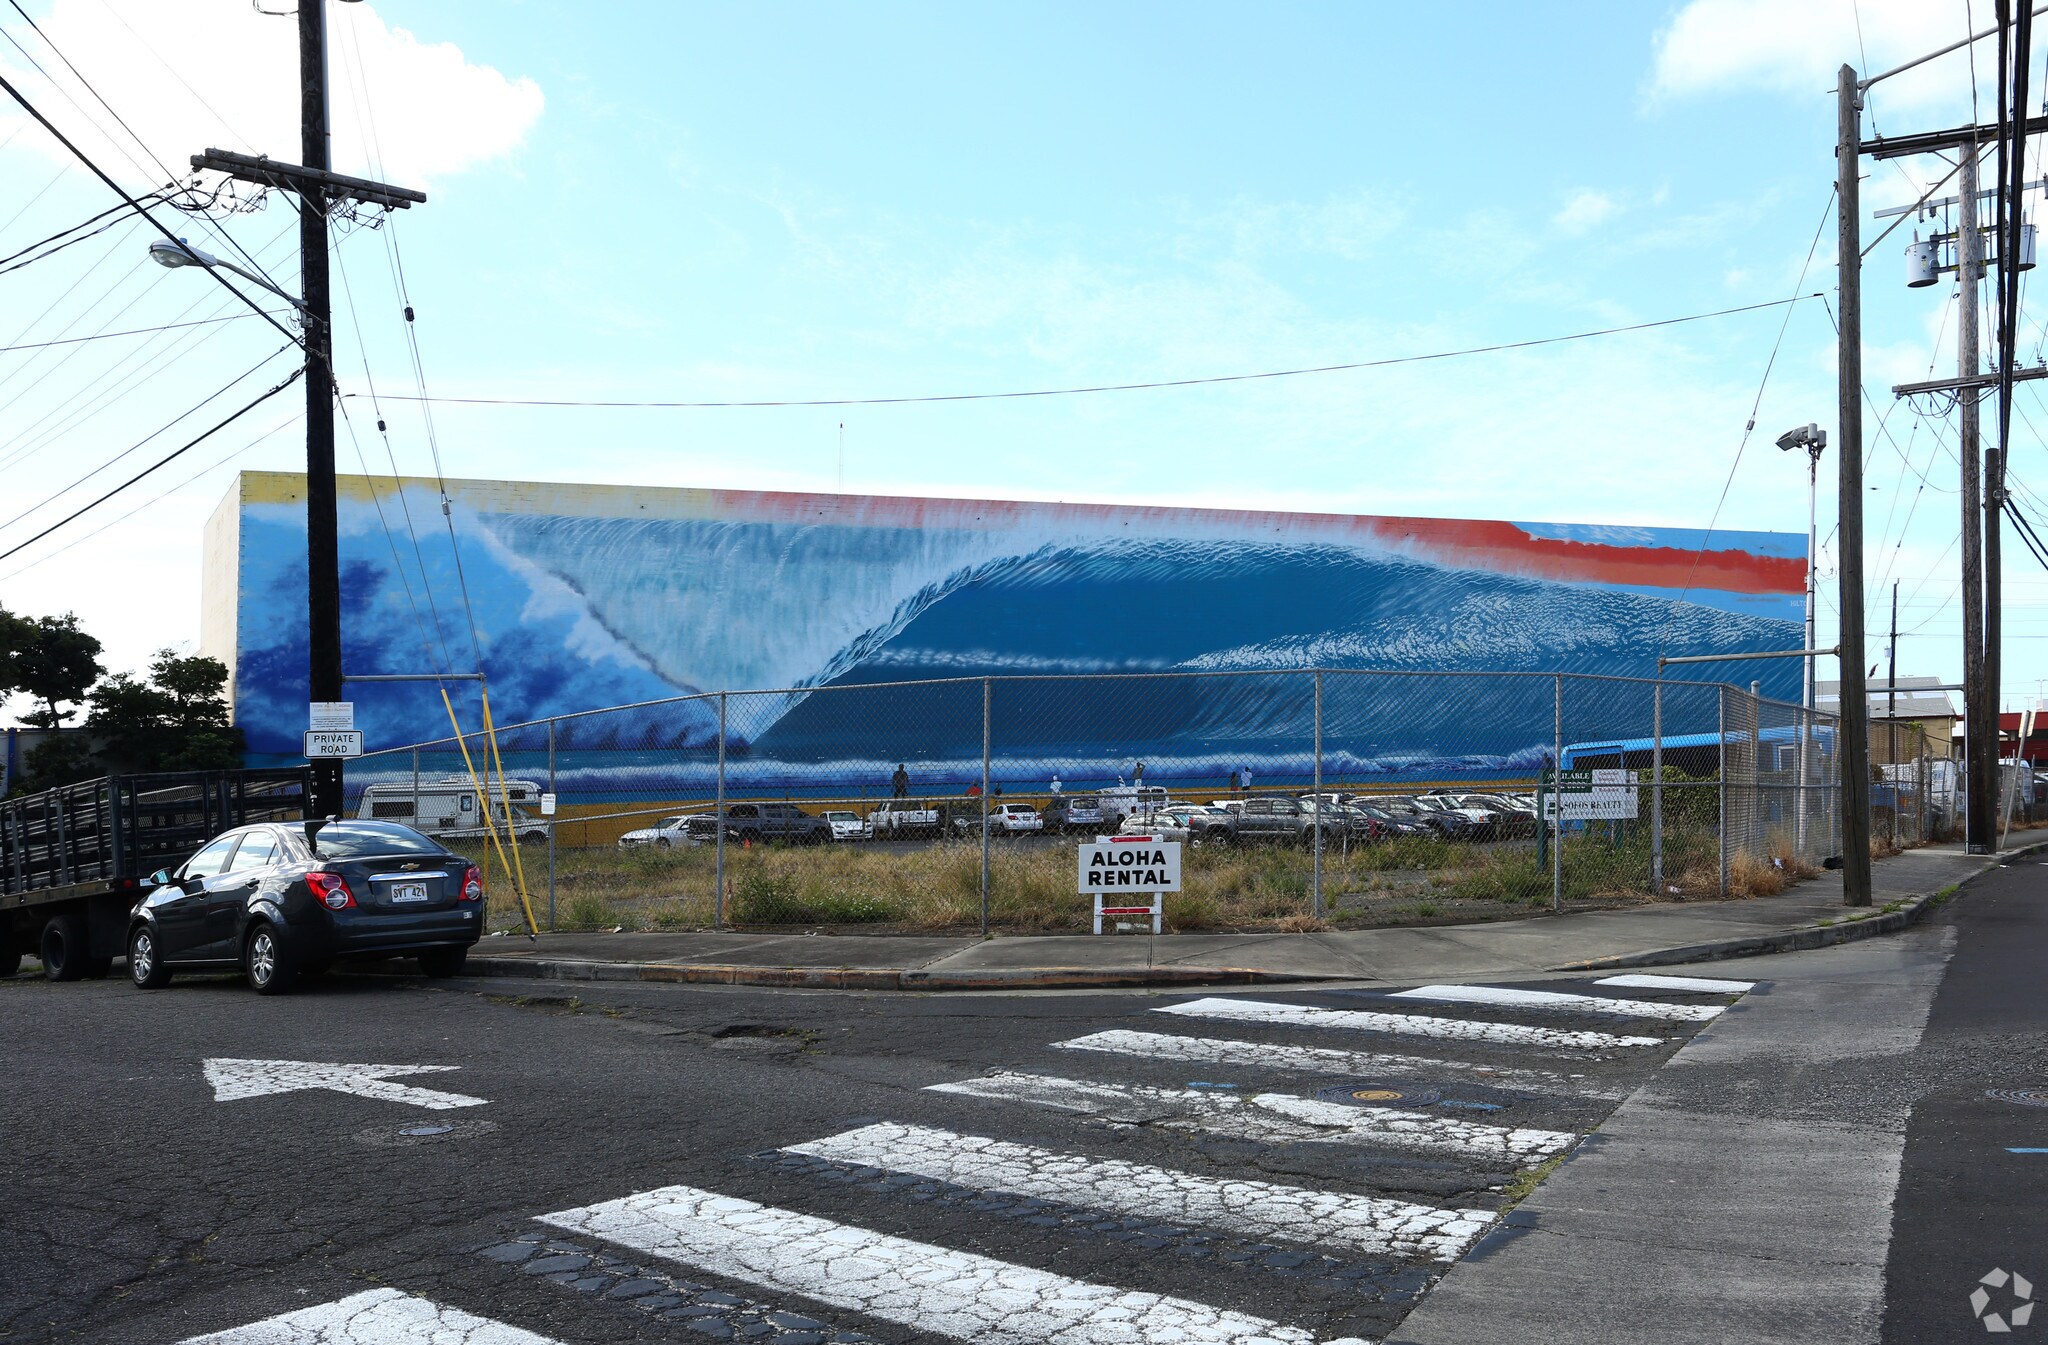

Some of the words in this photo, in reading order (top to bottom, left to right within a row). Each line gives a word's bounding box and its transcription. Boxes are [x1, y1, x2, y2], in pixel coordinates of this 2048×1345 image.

[313, 735, 354, 743] PRIVATE
[320, 745, 348, 753] ROAD
[1547, 772, 1590, 780] AVILABLE
[1590, 800, 1622, 809] REALTY
[1090, 850, 1166, 866] ALOHA
[1088, 869, 1171, 886] RENTAL
[393, 888, 407, 898] SVT
[412, 887, 425, 897] 421
